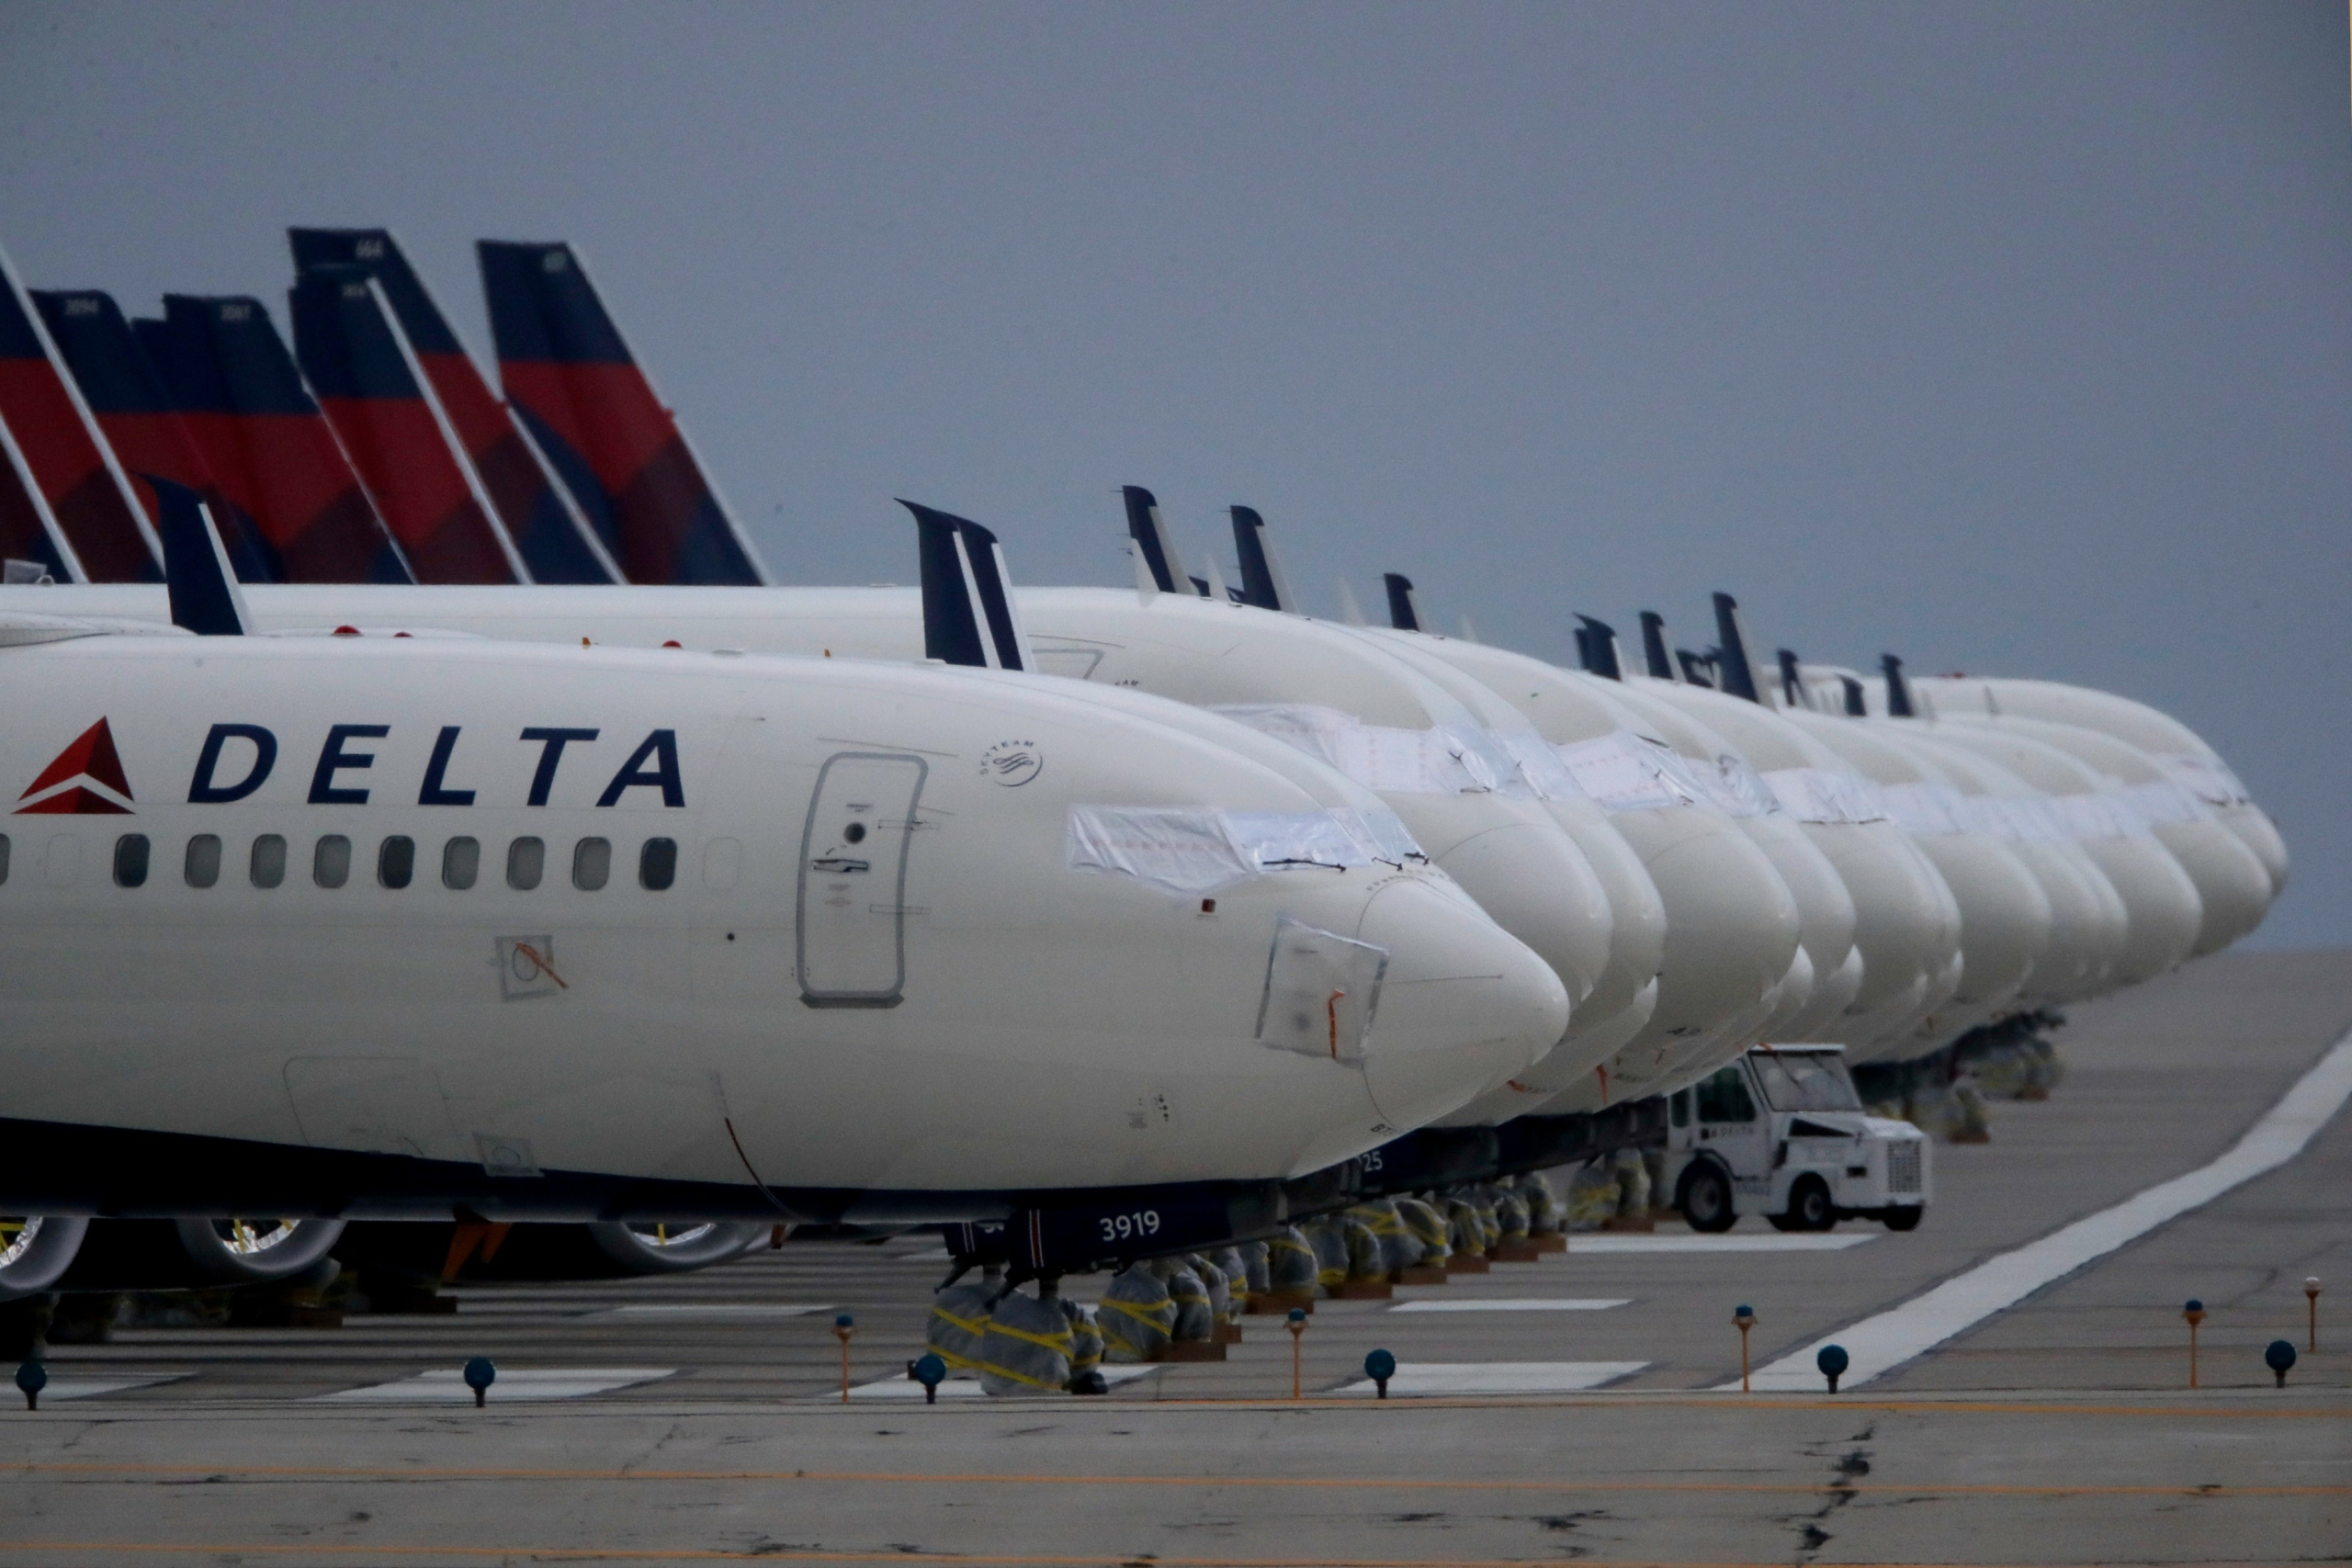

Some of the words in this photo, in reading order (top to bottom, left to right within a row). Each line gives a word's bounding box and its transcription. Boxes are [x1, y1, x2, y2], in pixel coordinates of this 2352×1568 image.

[187, 723, 685, 807] DELTA
[978, 739, 1035, 776] SKYTEAM
[1099, 1210, 1161, 1242] 3919
